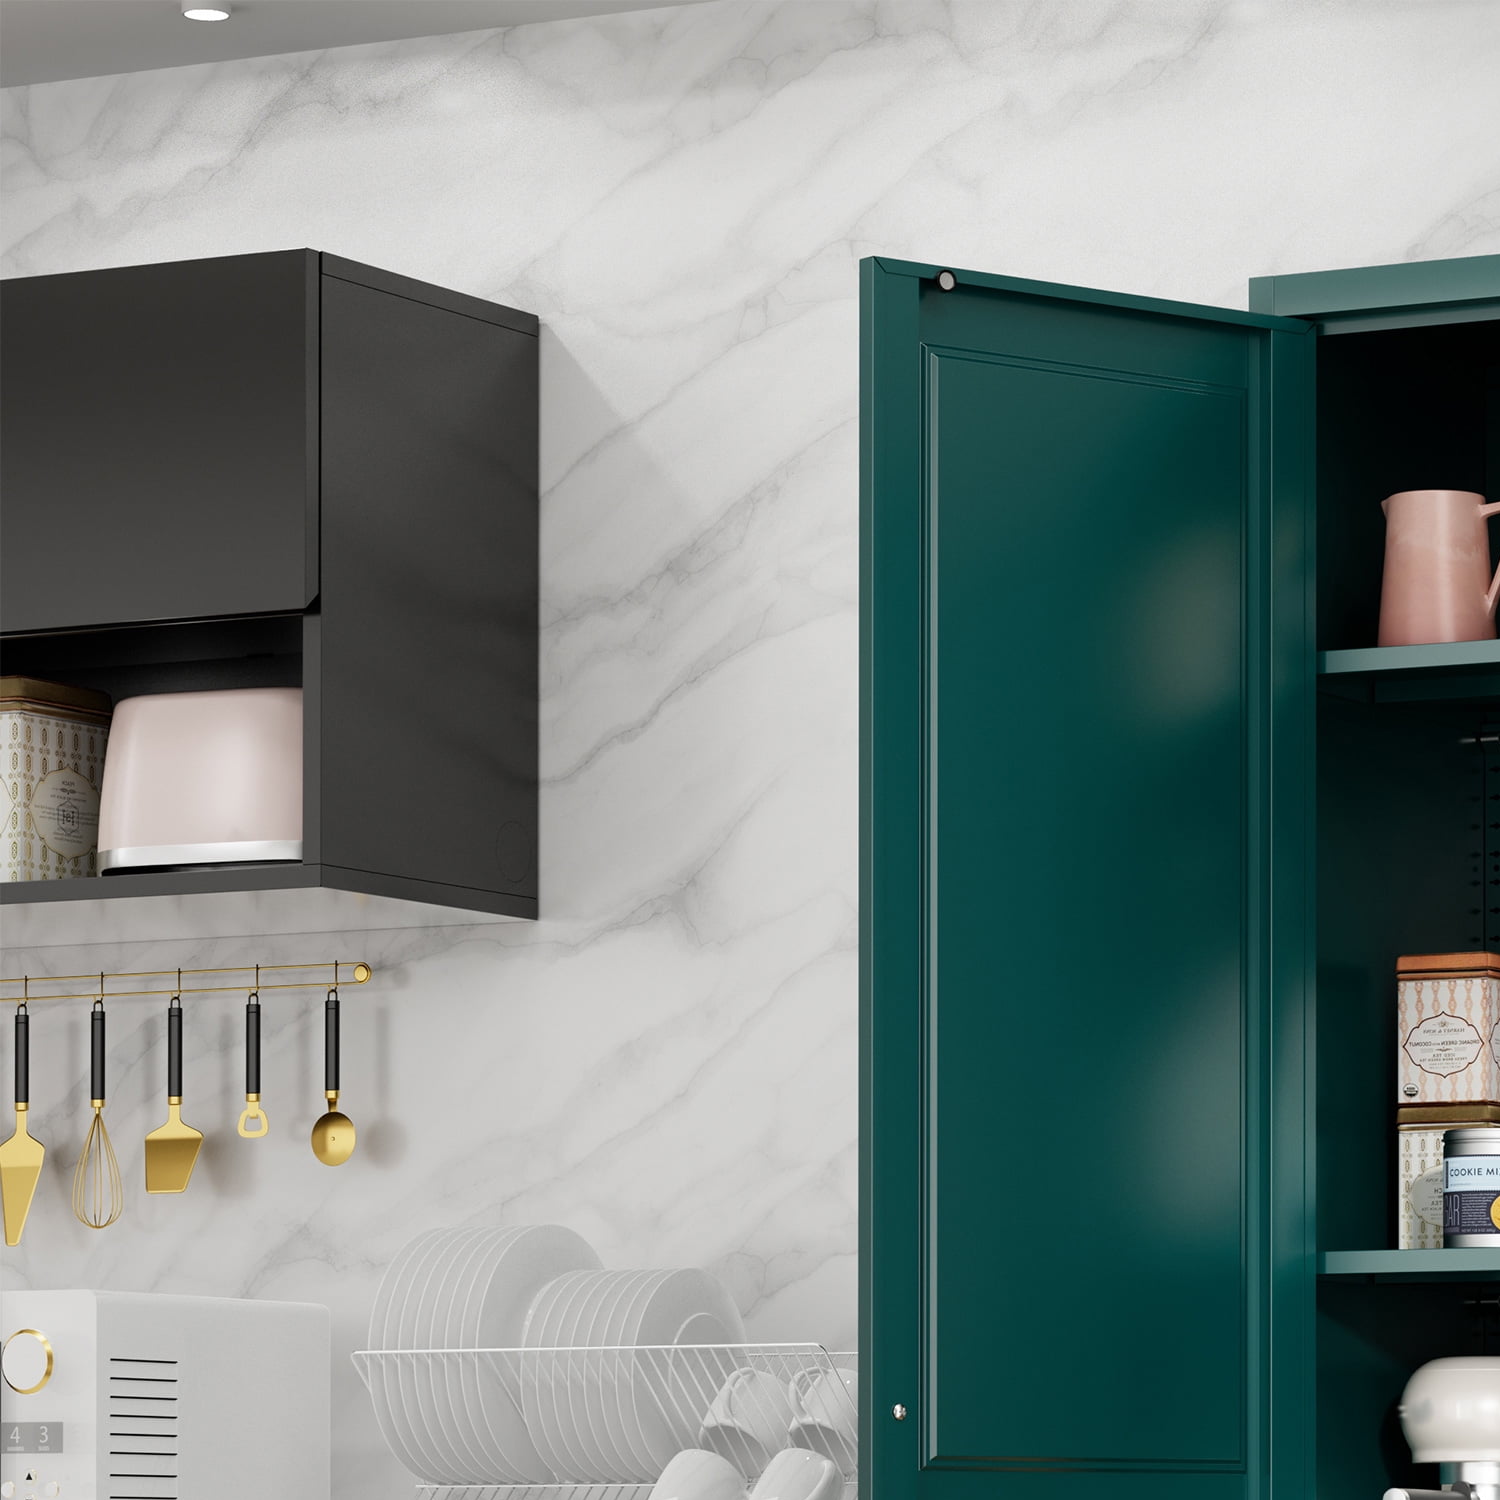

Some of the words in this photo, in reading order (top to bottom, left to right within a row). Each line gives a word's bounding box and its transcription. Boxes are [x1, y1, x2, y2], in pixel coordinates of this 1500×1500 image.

[1450, 1168, 1482, 1177] COOKIE
[10, 1426, 21, 1444] 4
[39, 1426, 48, 1444] 3
